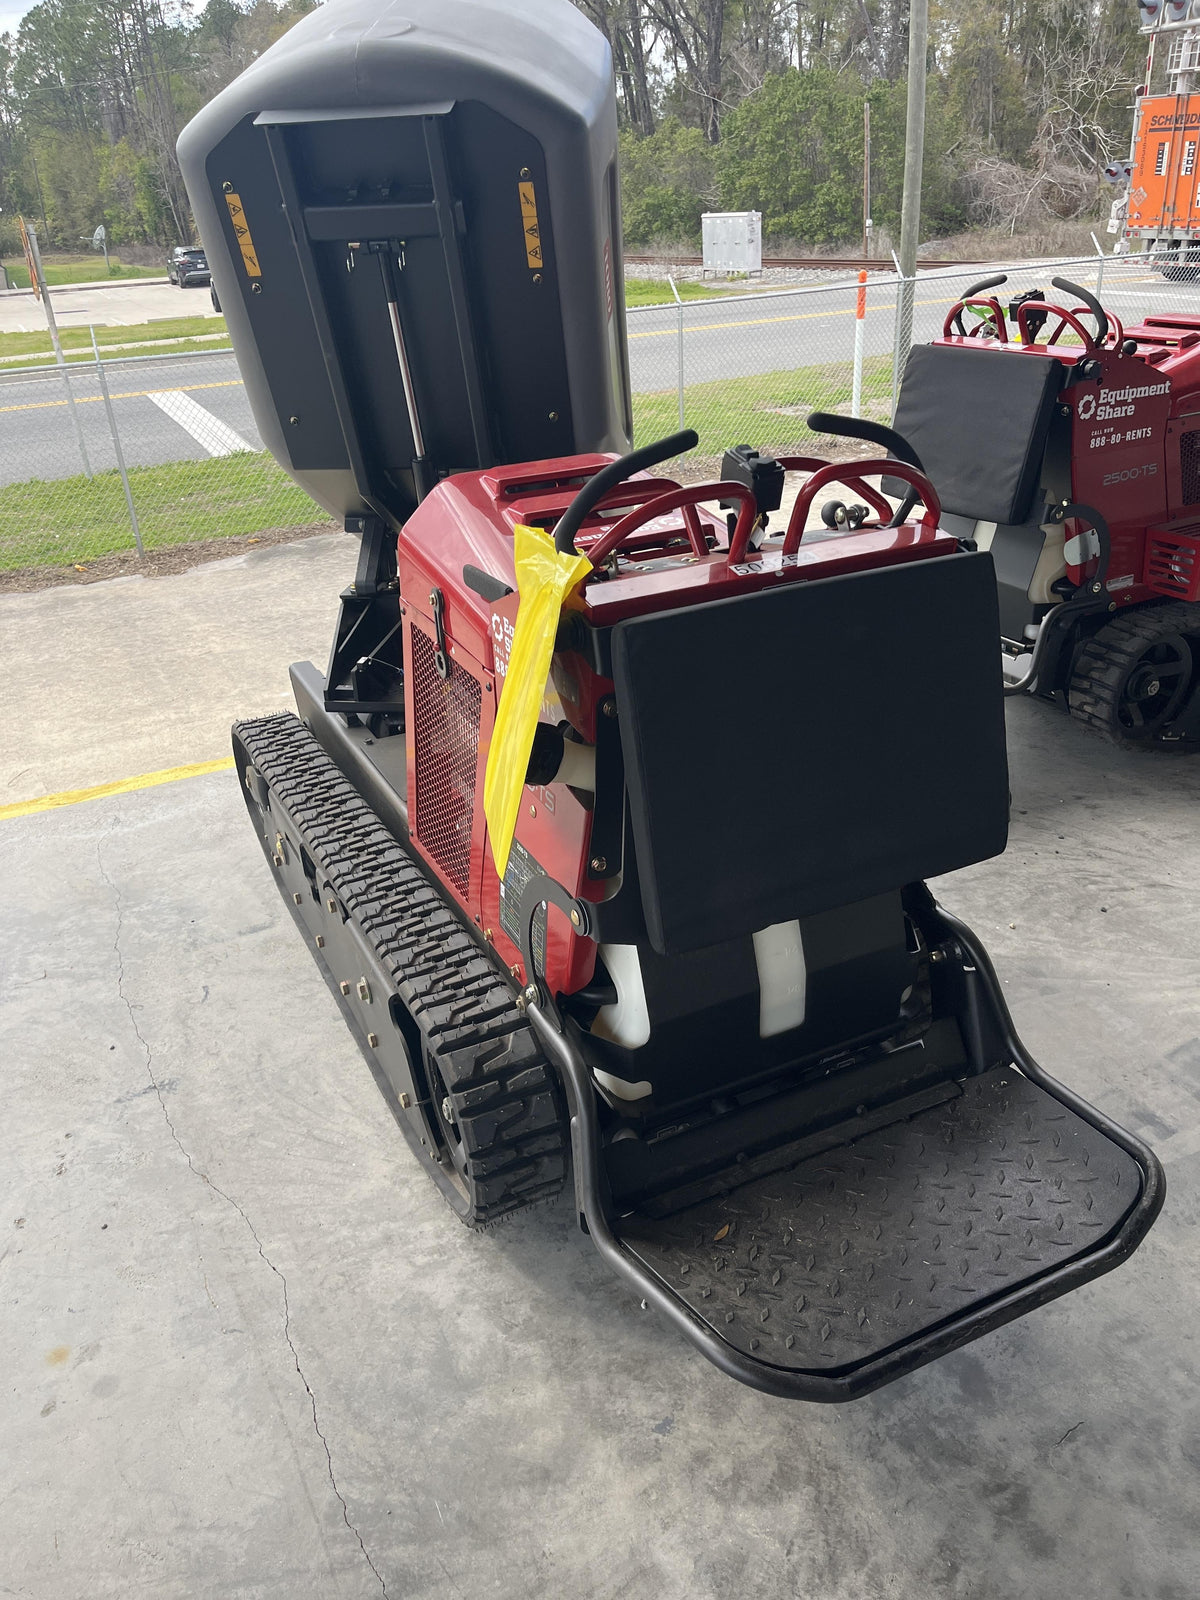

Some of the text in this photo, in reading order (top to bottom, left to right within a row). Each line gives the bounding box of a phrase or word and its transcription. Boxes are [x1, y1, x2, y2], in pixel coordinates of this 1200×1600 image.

[1098, 381, 1171, 404] Equipment
[1096, 405, 1135, 420] Share
[1090, 427, 1151, 448] 888-80-RENTS
